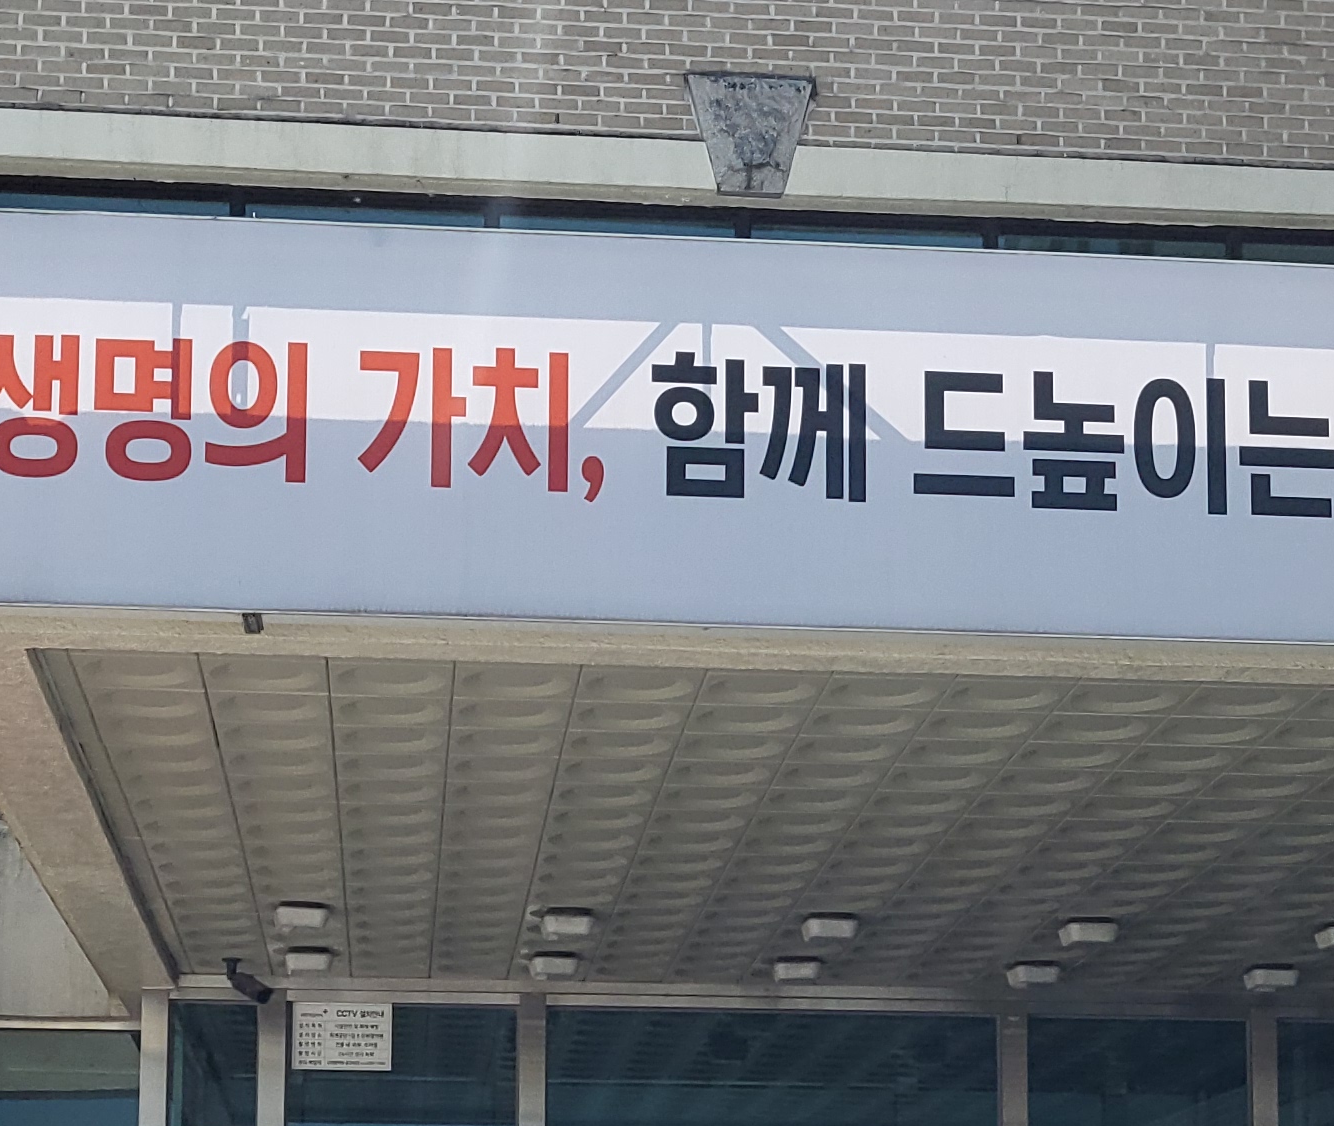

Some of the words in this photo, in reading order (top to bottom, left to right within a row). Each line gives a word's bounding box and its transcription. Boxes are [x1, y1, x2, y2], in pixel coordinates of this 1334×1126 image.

[357, 346, 605, 503] 가치,
[651, 351, 866, 503] 함께
[336, 1009, 358, 1018] CCTV
